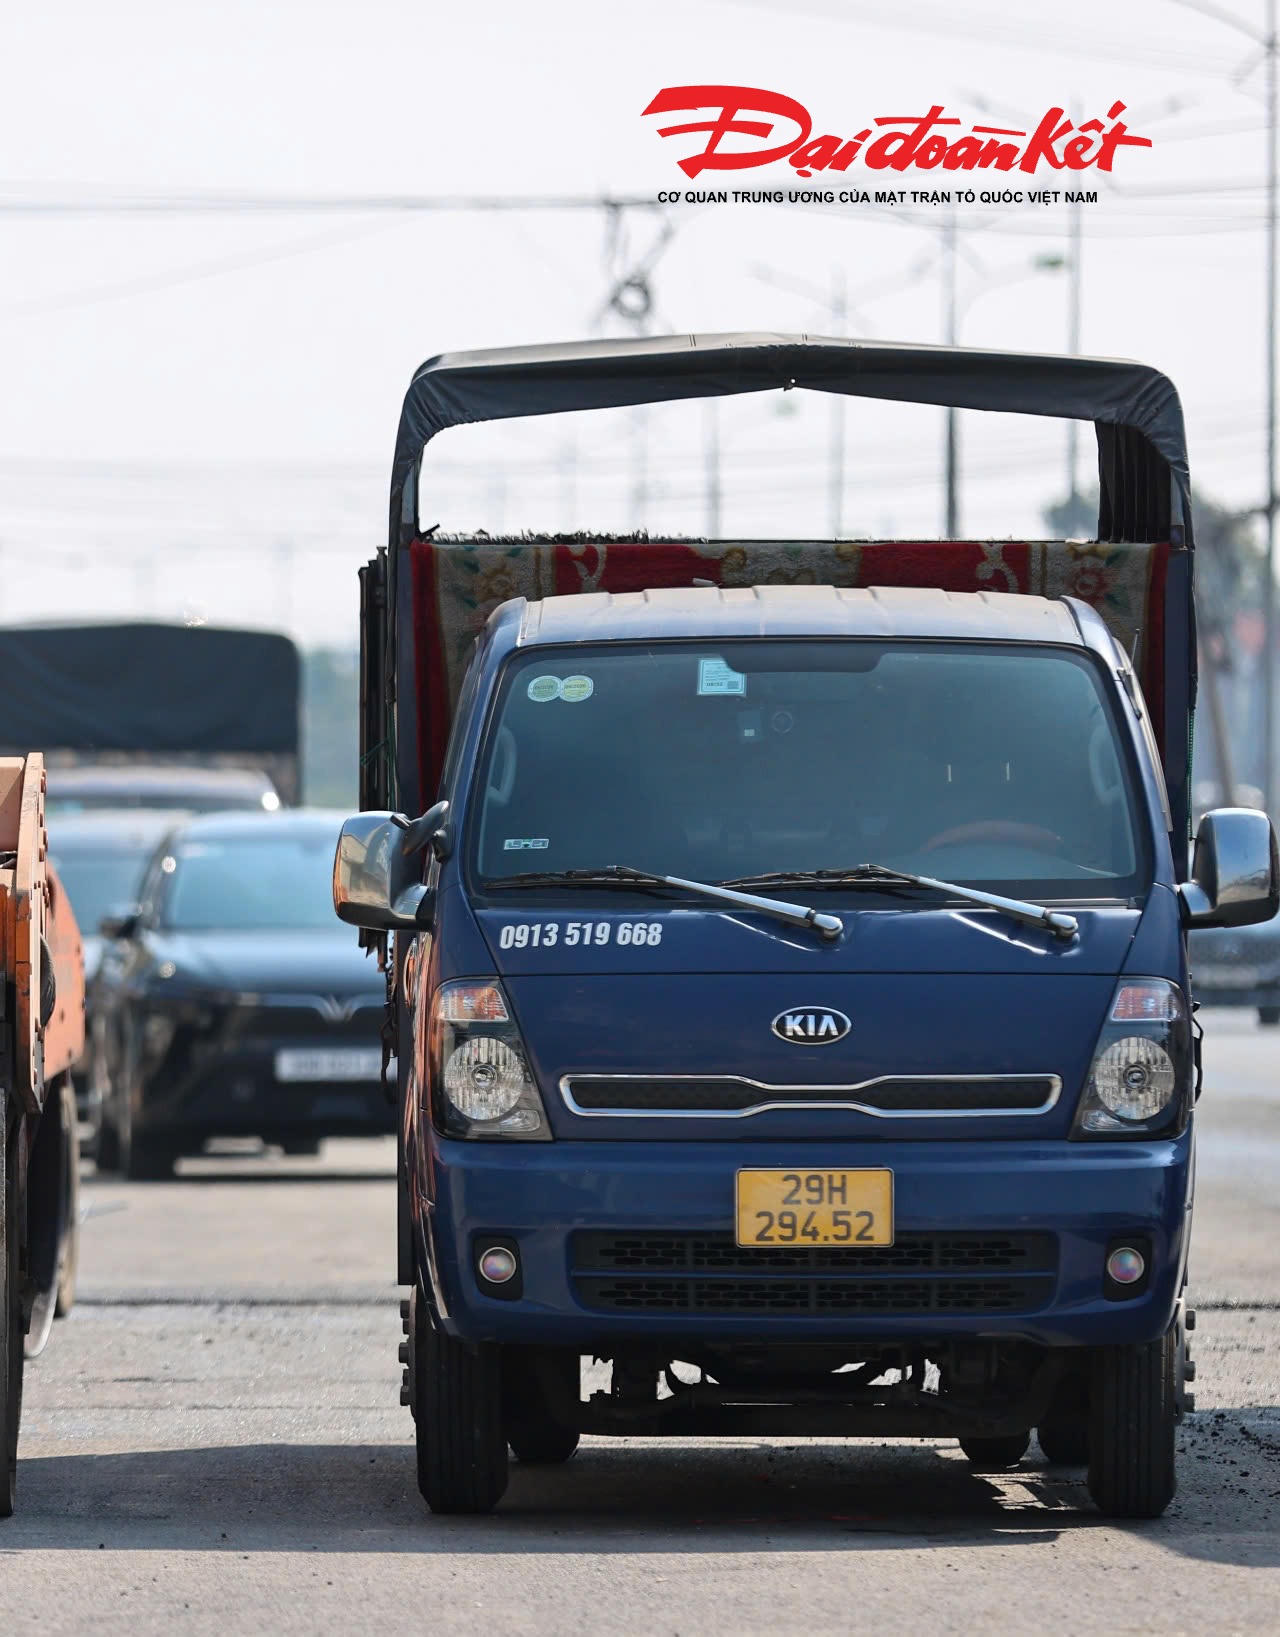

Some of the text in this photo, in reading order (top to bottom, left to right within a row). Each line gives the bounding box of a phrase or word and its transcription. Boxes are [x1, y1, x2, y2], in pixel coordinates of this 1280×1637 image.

[499, 922, 663, 950] 0913 519 668
[784, 1013, 840, 1038] KIA
[781, 1174, 847, 1205] 29H
[755, 1210, 875, 1242] 294.52
